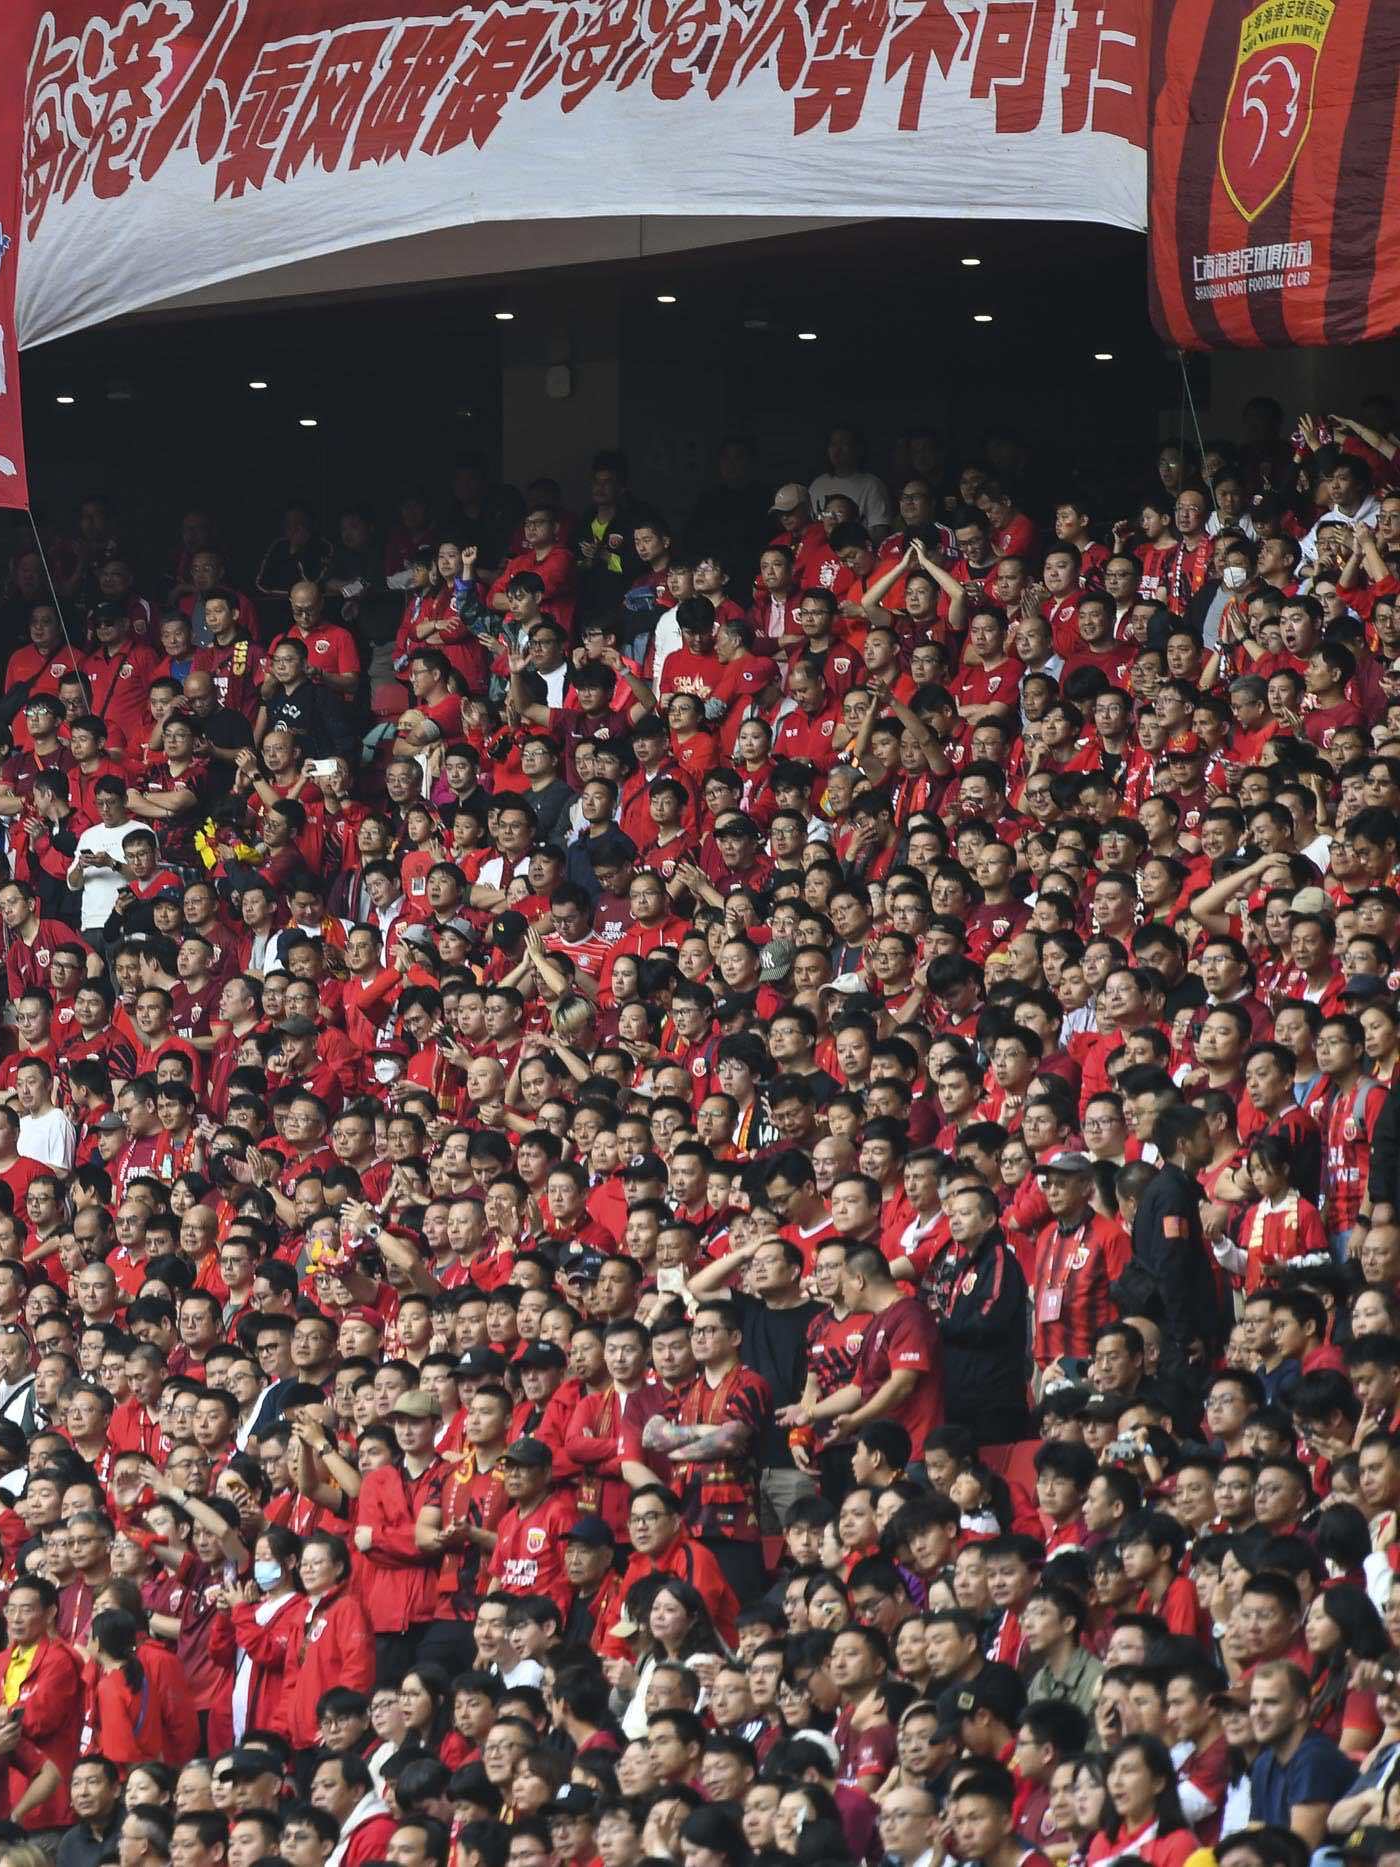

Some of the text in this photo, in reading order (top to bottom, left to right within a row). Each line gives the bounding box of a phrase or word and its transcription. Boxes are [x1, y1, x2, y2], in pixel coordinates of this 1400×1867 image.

[1192, 240, 1312, 282] 上海海港足球俱乐部
[1195, 271, 1311, 301] SHANGHAI PORT FOOTBALL CLUB
